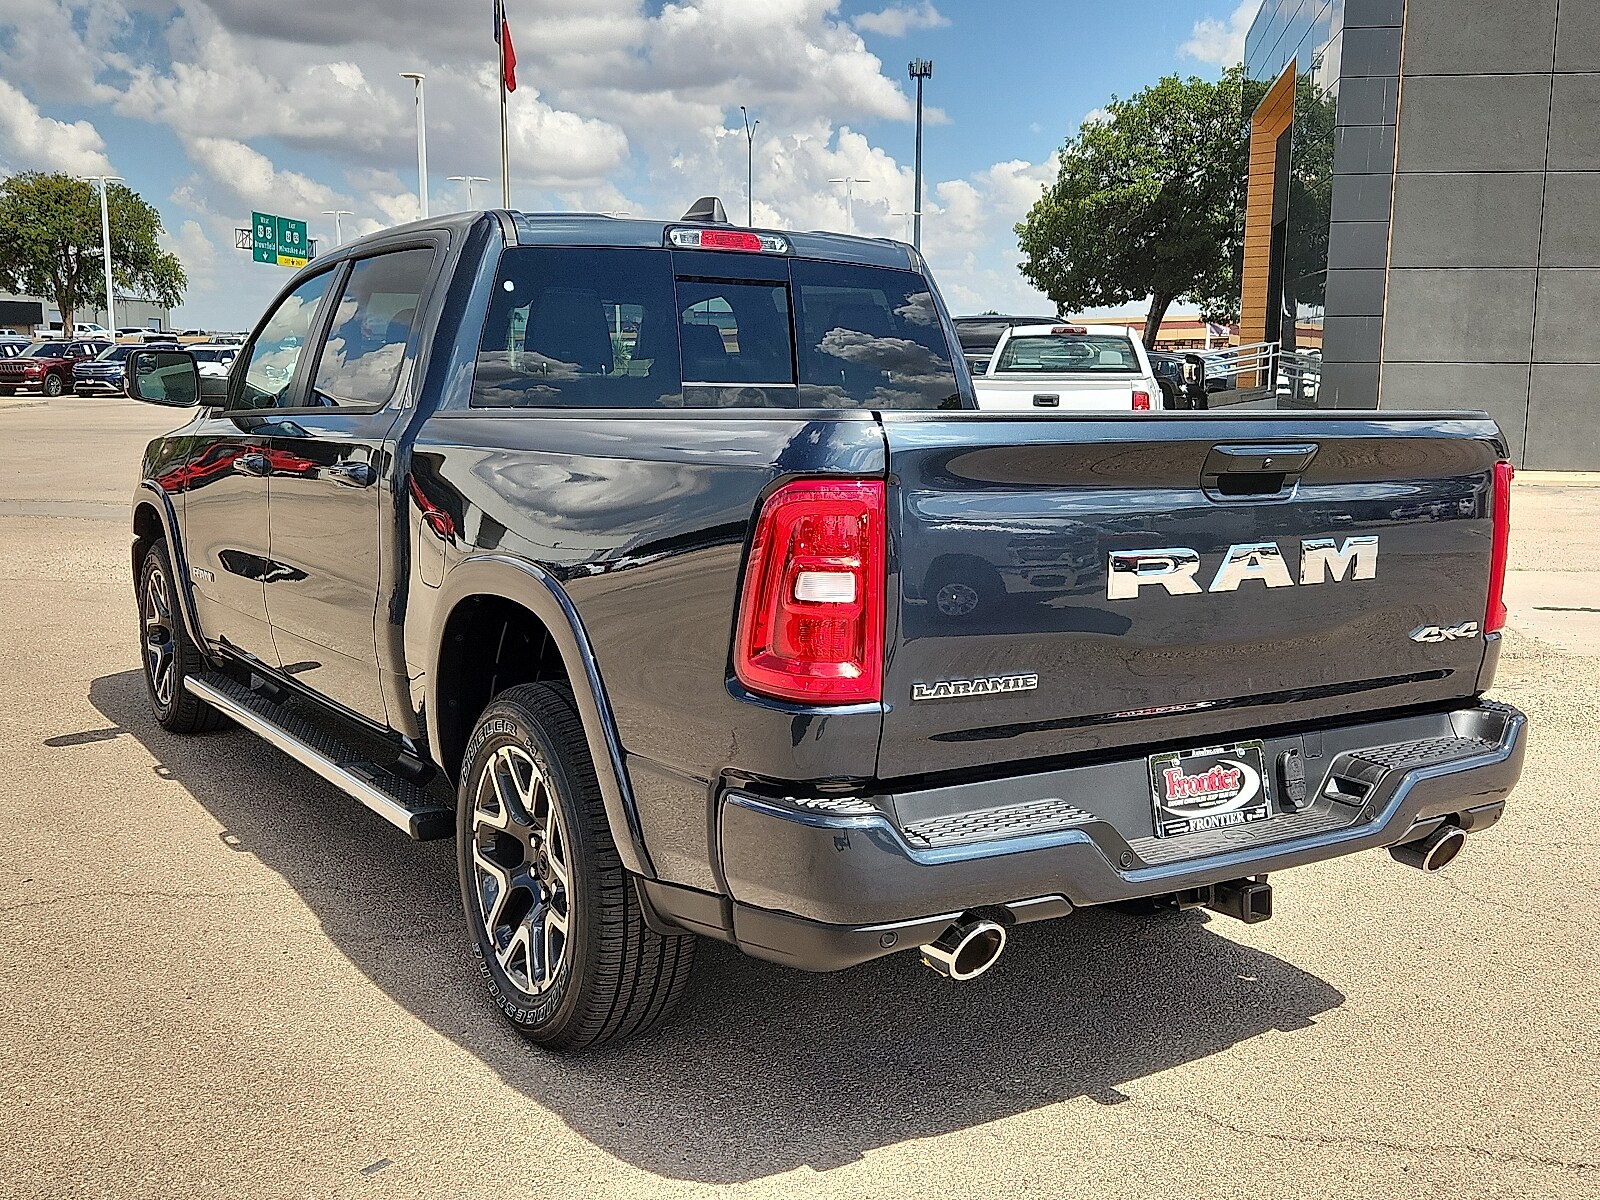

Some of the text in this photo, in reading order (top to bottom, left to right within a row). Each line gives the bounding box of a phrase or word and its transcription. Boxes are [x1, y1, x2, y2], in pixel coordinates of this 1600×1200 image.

[1107, 536, 1379, 600] RAM
[912, 674, 1038, 700] LARAMIE
[461, 720, 517, 787] DUELER
[1163, 765, 1240, 799] Frontier
[1189, 811, 1245, 831] FRONTIER
